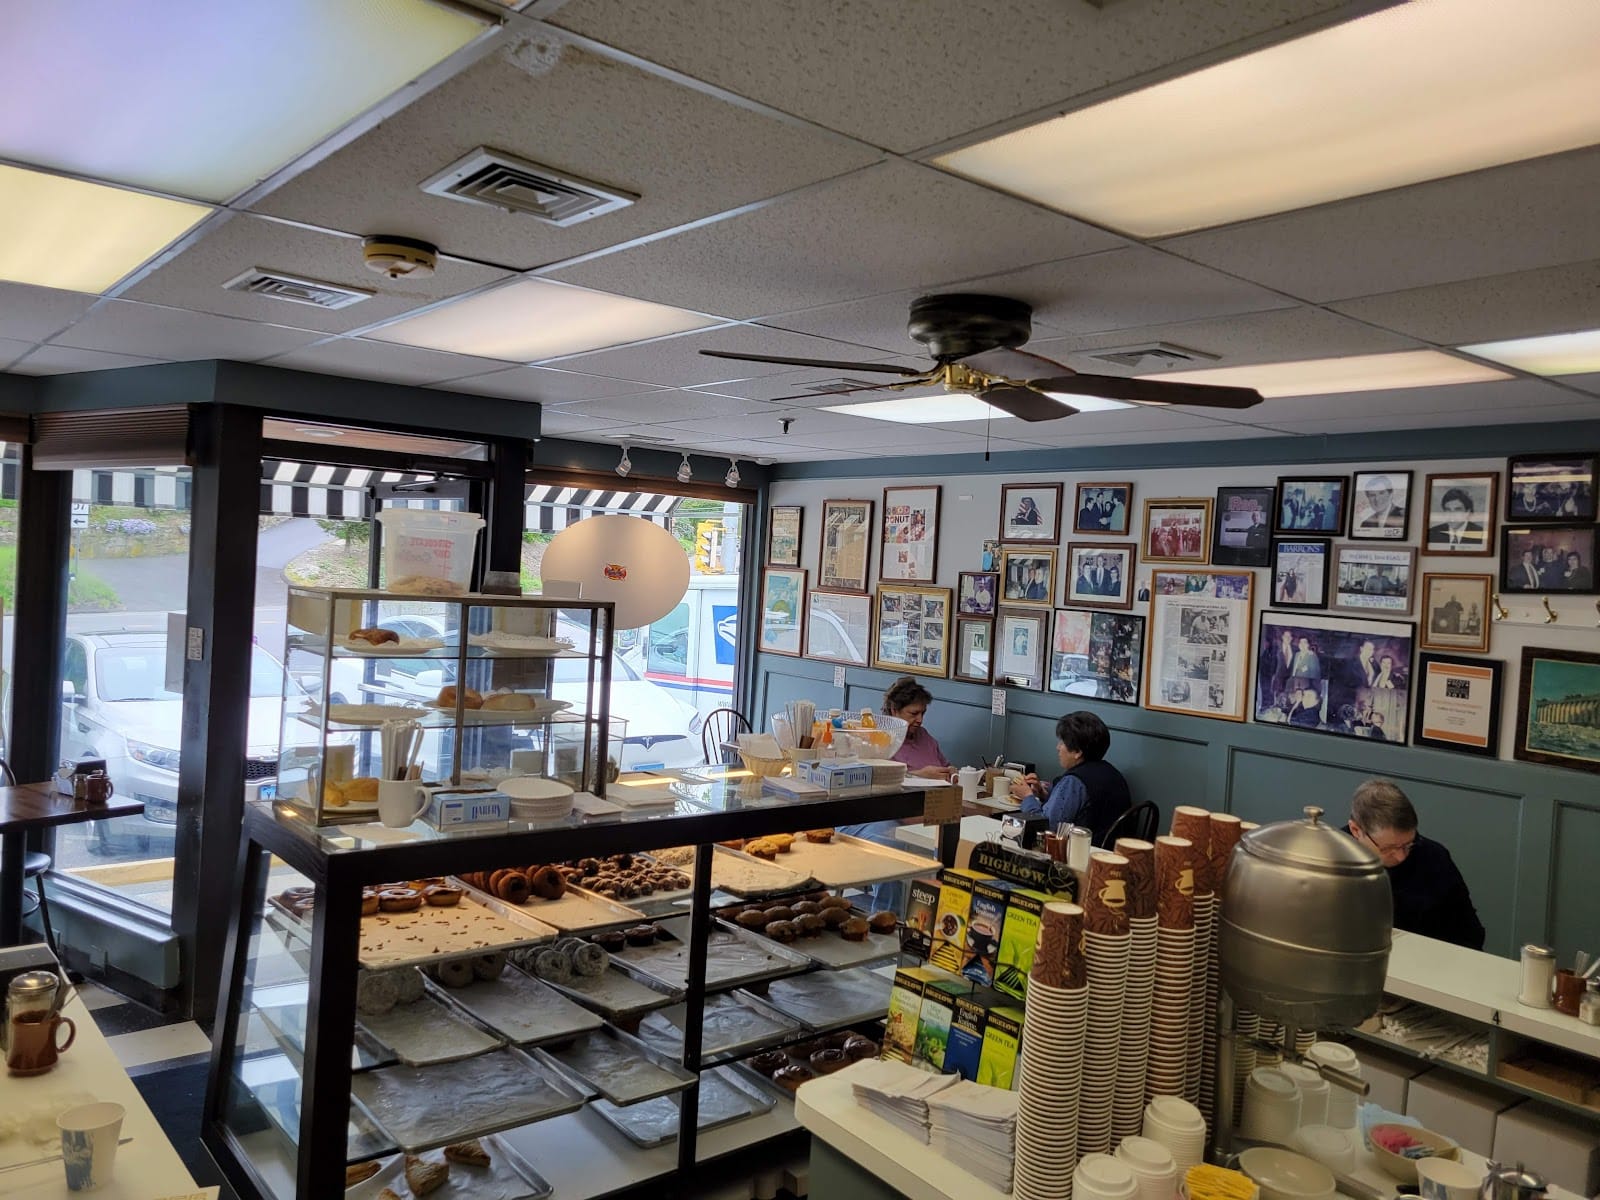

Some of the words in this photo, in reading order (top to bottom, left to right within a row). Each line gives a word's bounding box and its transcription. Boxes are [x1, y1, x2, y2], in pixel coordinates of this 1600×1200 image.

[979, 853, 1046, 883] BIGELOW
[912, 888, 936, 906] steep
[1492, 1009, 1501, 1025] 4
